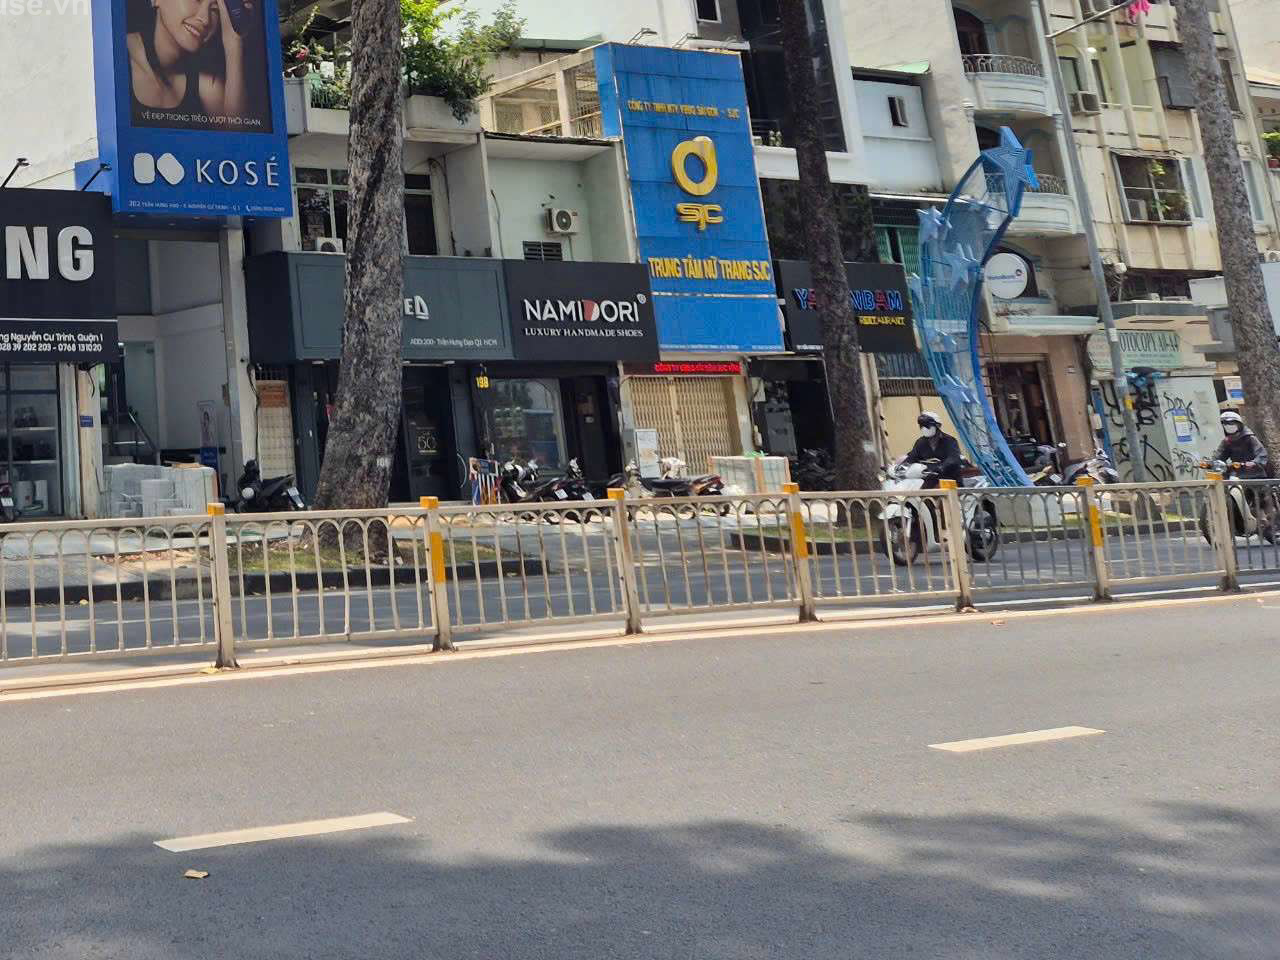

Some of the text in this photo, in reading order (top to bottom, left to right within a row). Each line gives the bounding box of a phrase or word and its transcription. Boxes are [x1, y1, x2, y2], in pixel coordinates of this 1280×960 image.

[196, 156, 279, 187] KOSÉ
[648, 257, 680, 278] TRUNG
[719, 259, 752, 280] TRANG
[10, 330, 41, 343] Nguyễn
[77, 332, 99, 344] Quận
[524, 328, 644, 337] LUXURY HANDMADE SHOES
[23, 342, 36, 351] 202
[38, 342, 51, 351] 203
[1119, 332, 1157, 353] OTOCOPY
